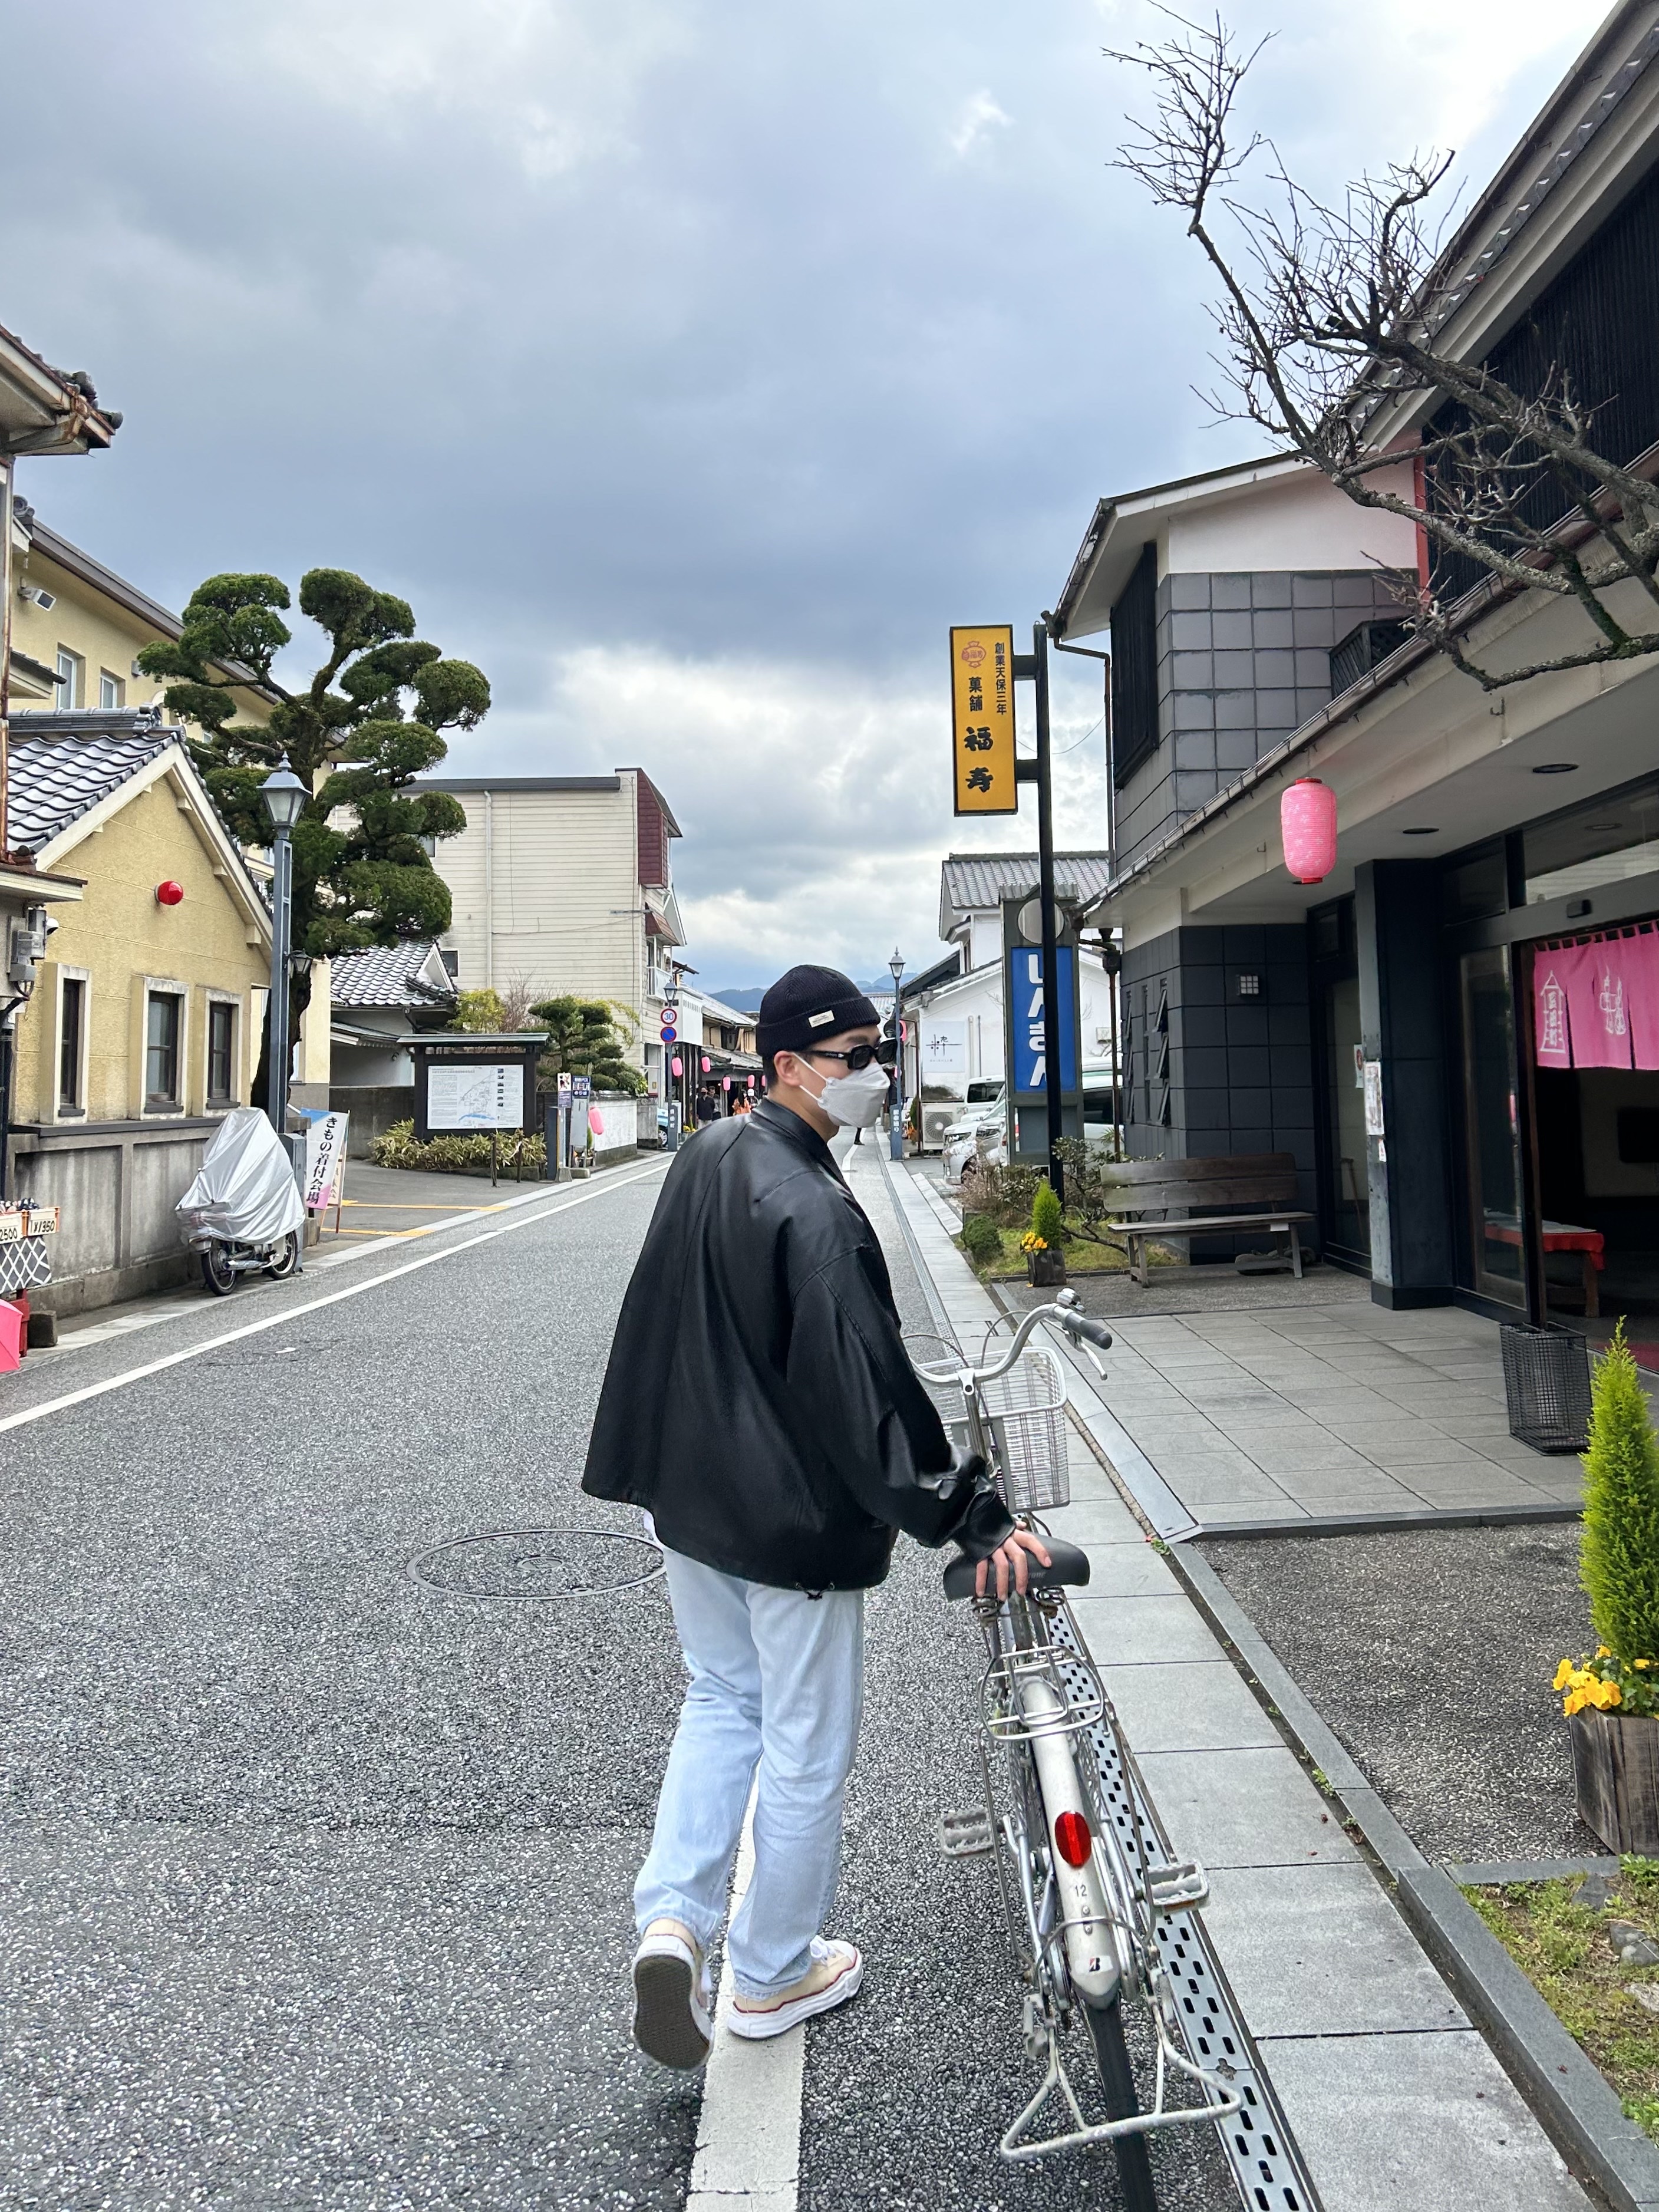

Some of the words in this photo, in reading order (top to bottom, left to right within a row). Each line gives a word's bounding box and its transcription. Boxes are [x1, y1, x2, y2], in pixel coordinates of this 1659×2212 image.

[995, 642, 1007, 716] 創業天保三年
[964, 726, 994, 793] 福寿
[306, 1116, 338, 1205] きもの着付会場
[33, 1219, 55, 1233] ¥1350
[1074, 1885, 1087, 1897] 12
